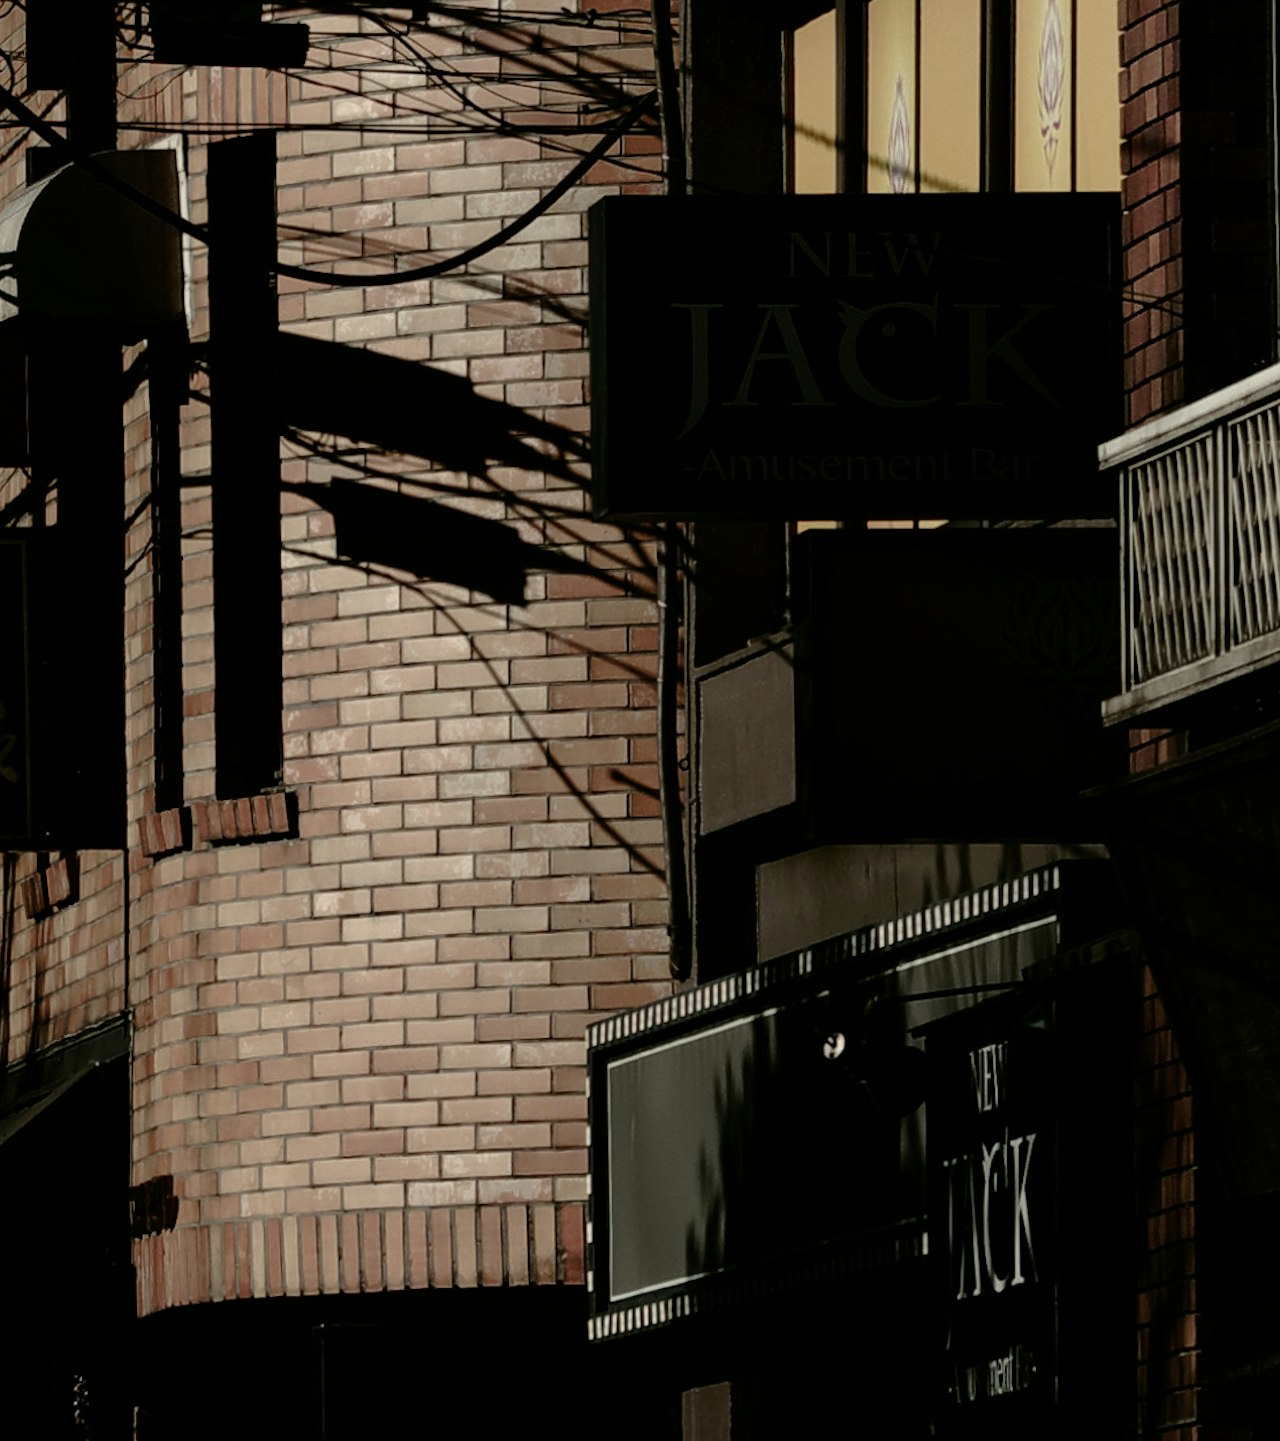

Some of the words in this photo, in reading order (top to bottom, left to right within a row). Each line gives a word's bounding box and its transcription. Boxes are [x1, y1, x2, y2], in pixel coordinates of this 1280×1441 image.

[787, 230, 946, 280] NEW
[670, 294, 1062, 441] JACK
[969, 1040, 1009, 1114] NEW
